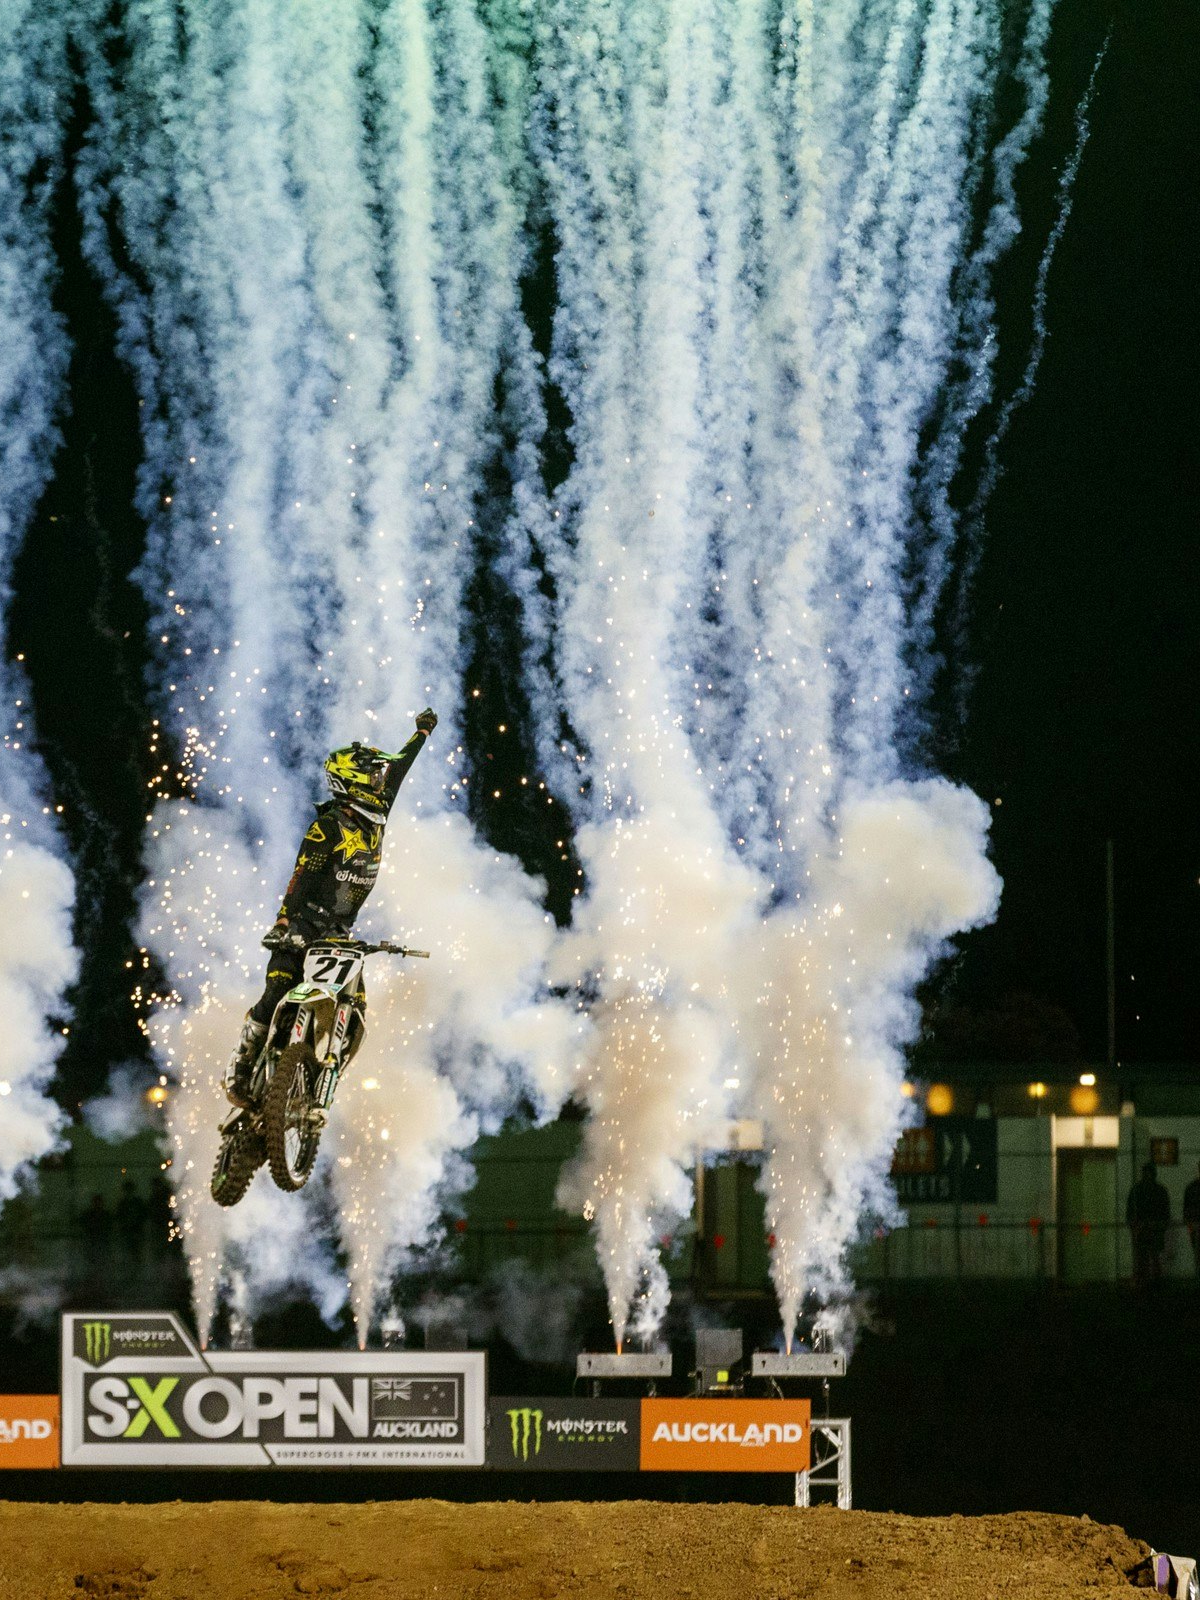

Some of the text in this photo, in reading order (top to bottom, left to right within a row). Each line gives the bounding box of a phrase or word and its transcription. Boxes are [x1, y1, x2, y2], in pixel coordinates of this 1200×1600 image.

[312, 957, 355, 985] 21
[113, 1330, 176, 1342] MONSTER
[182, 1376, 369, 1439] OPEN
[372, 1422, 459, 1438] AUCKLAND
[546, 1418, 628, 1434] MONSTER
[652, 1422, 802, 1443] AUCKLAND
[276, 1451, 344, 1459] SUPERCROSS
[356, 1451, 378, 1459] FMX
[382, 1451, 465, 1459] INTERNATIONAL
